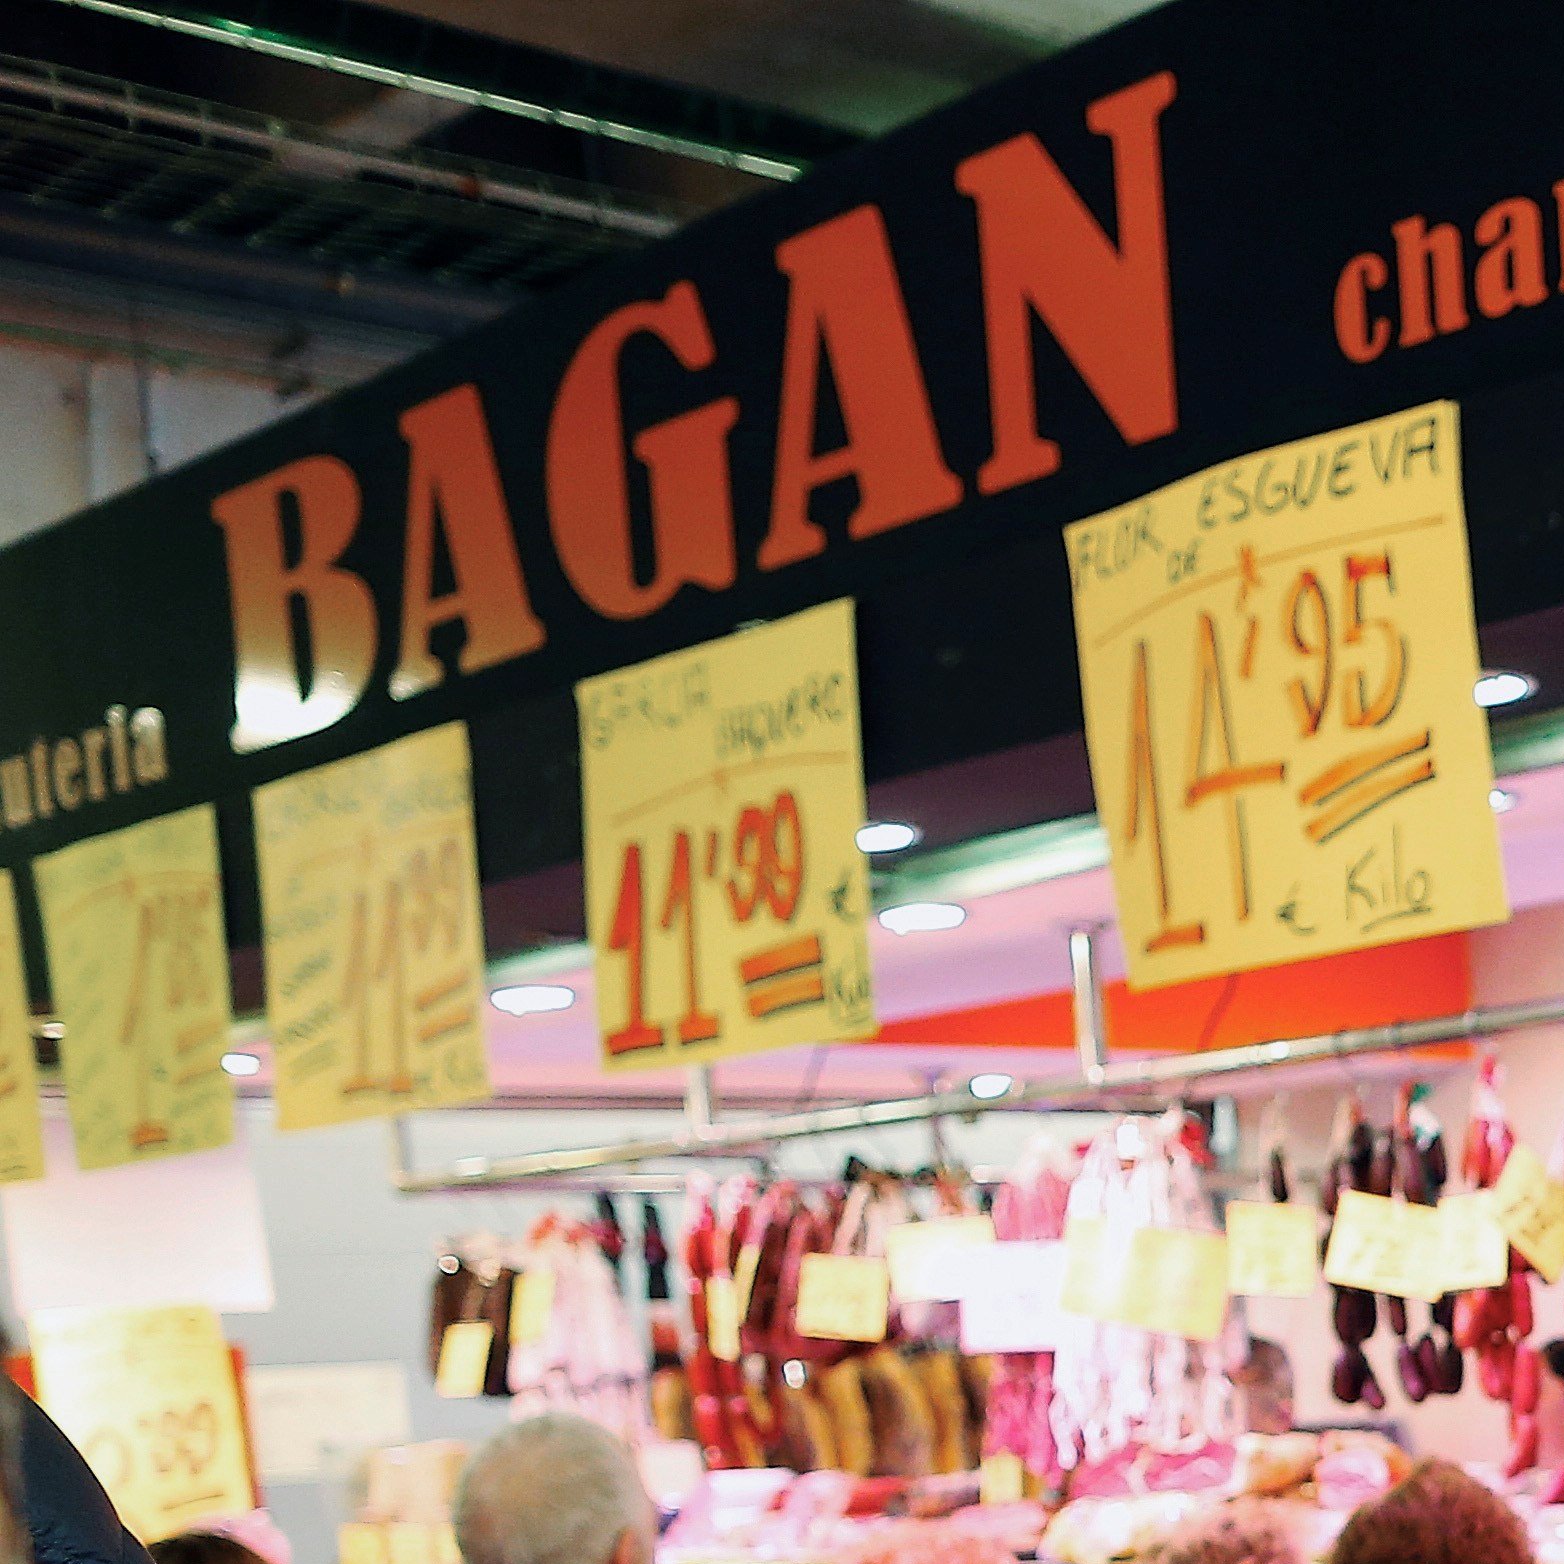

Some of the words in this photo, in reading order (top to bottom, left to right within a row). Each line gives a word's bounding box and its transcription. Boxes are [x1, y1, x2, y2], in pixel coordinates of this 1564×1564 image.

[211, 70, 1179, 756] BAGAN
[1072, 504, 1165, 588] FLOR
[1195, 416, 1442, 530] ESGUEVA
